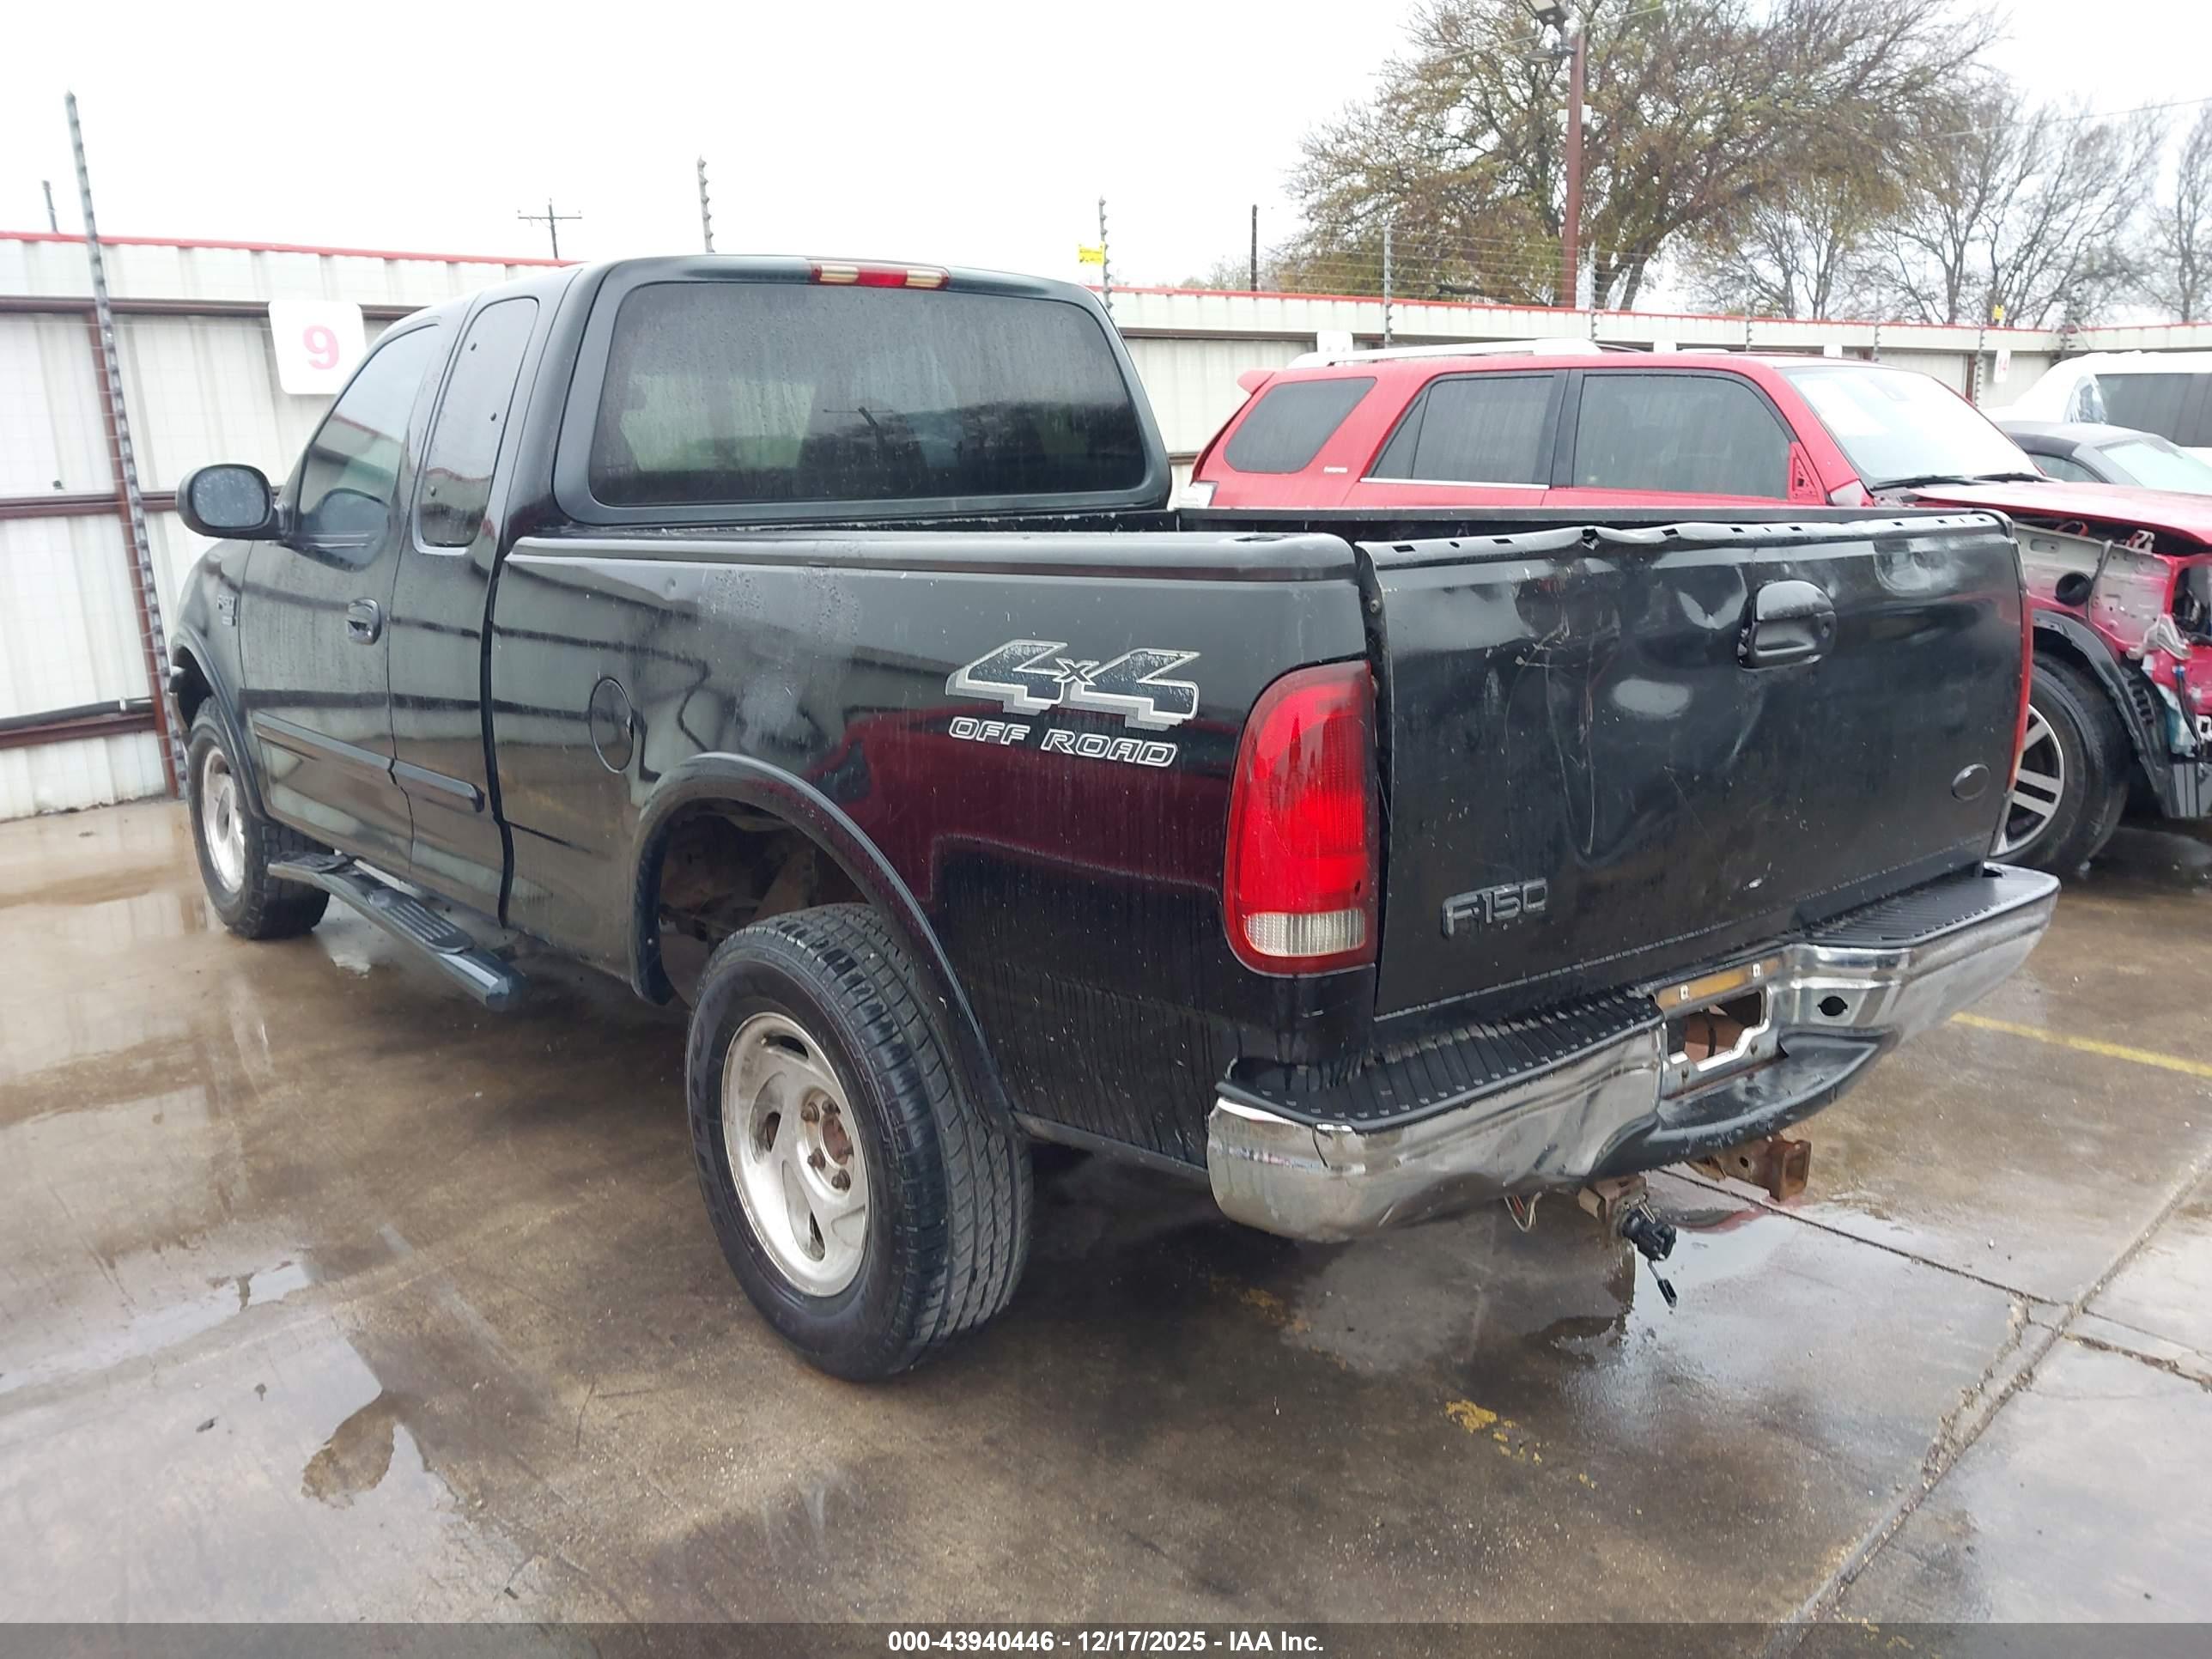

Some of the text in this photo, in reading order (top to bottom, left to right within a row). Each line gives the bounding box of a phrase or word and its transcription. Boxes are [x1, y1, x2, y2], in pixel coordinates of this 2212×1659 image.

[302, 325, 339, 370] 9
[948, 716, 1178, 767] OFF ROAD
